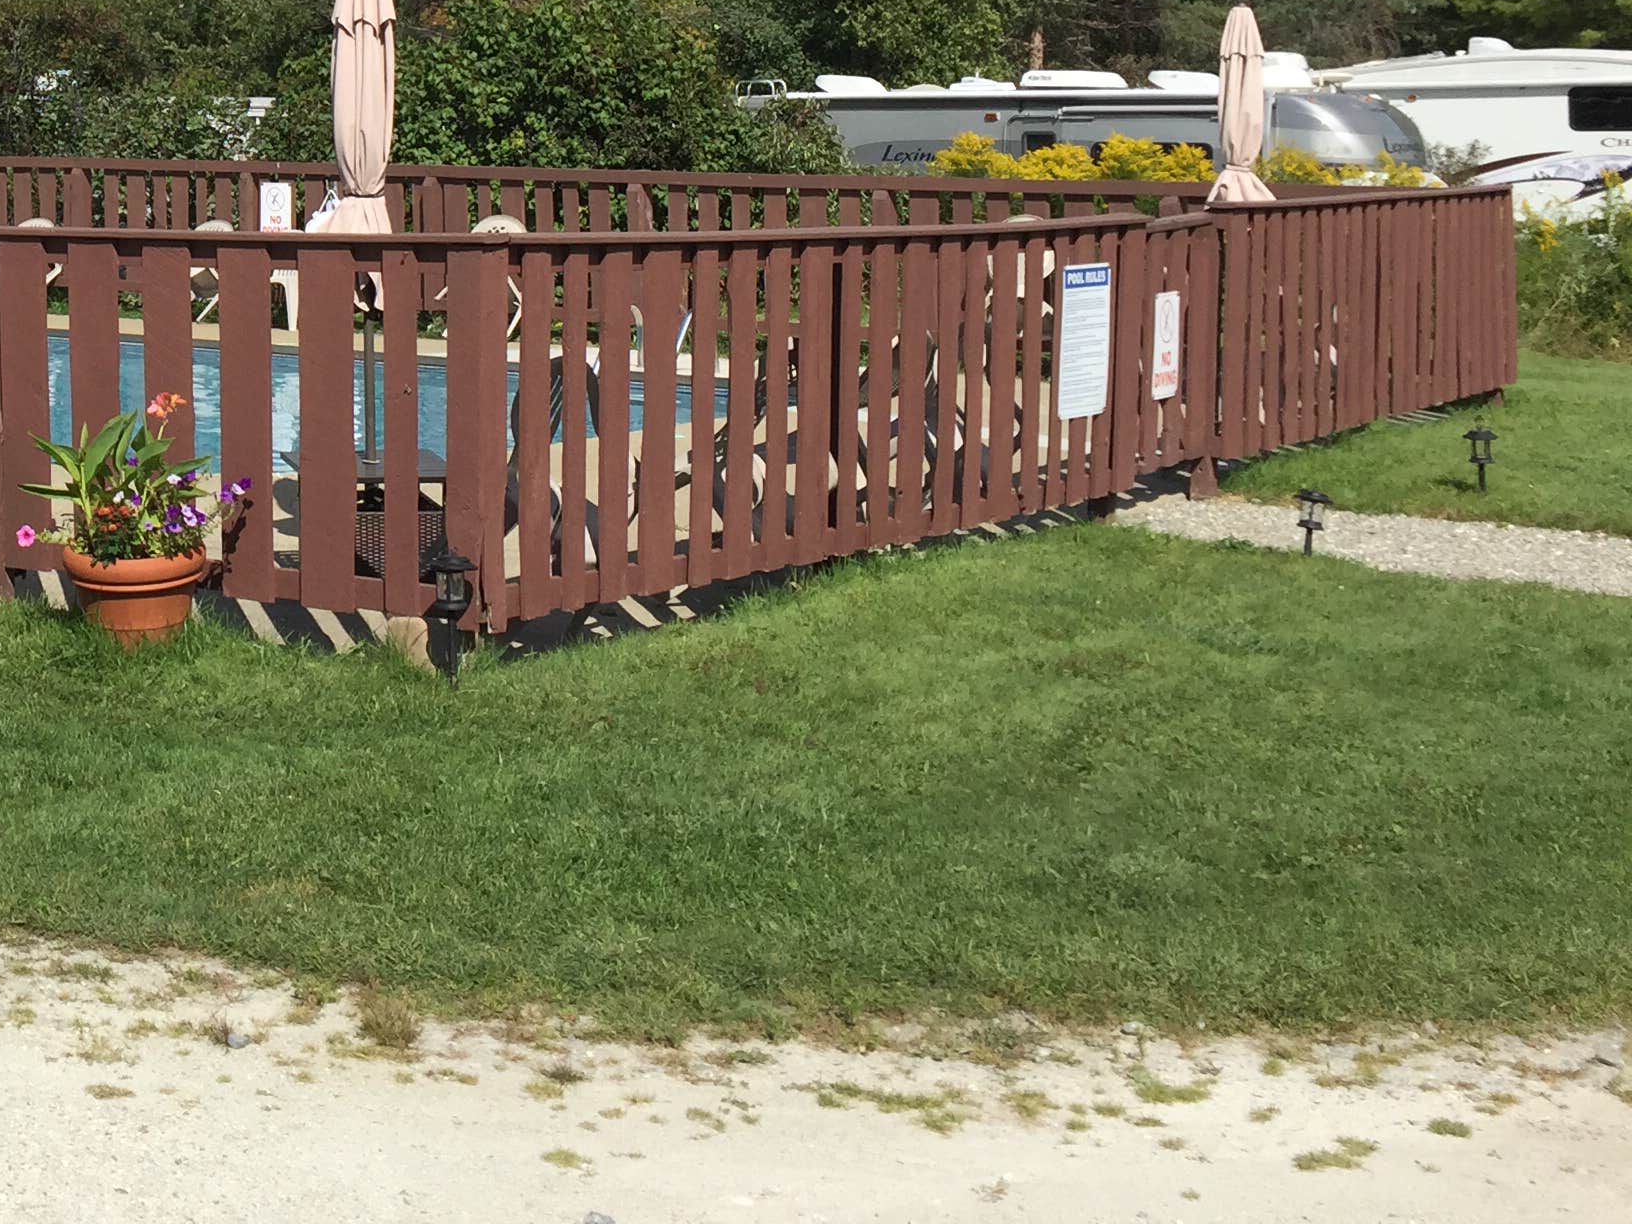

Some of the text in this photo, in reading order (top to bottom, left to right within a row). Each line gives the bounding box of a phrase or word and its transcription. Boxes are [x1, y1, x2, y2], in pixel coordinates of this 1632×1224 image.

[270, 215, 281, 224] NO
[1068, 270, 1106, 285] POOL RULES
[1161, 351, 1171, 366] NO
[1154, 370, 1176, 388] DIVING
